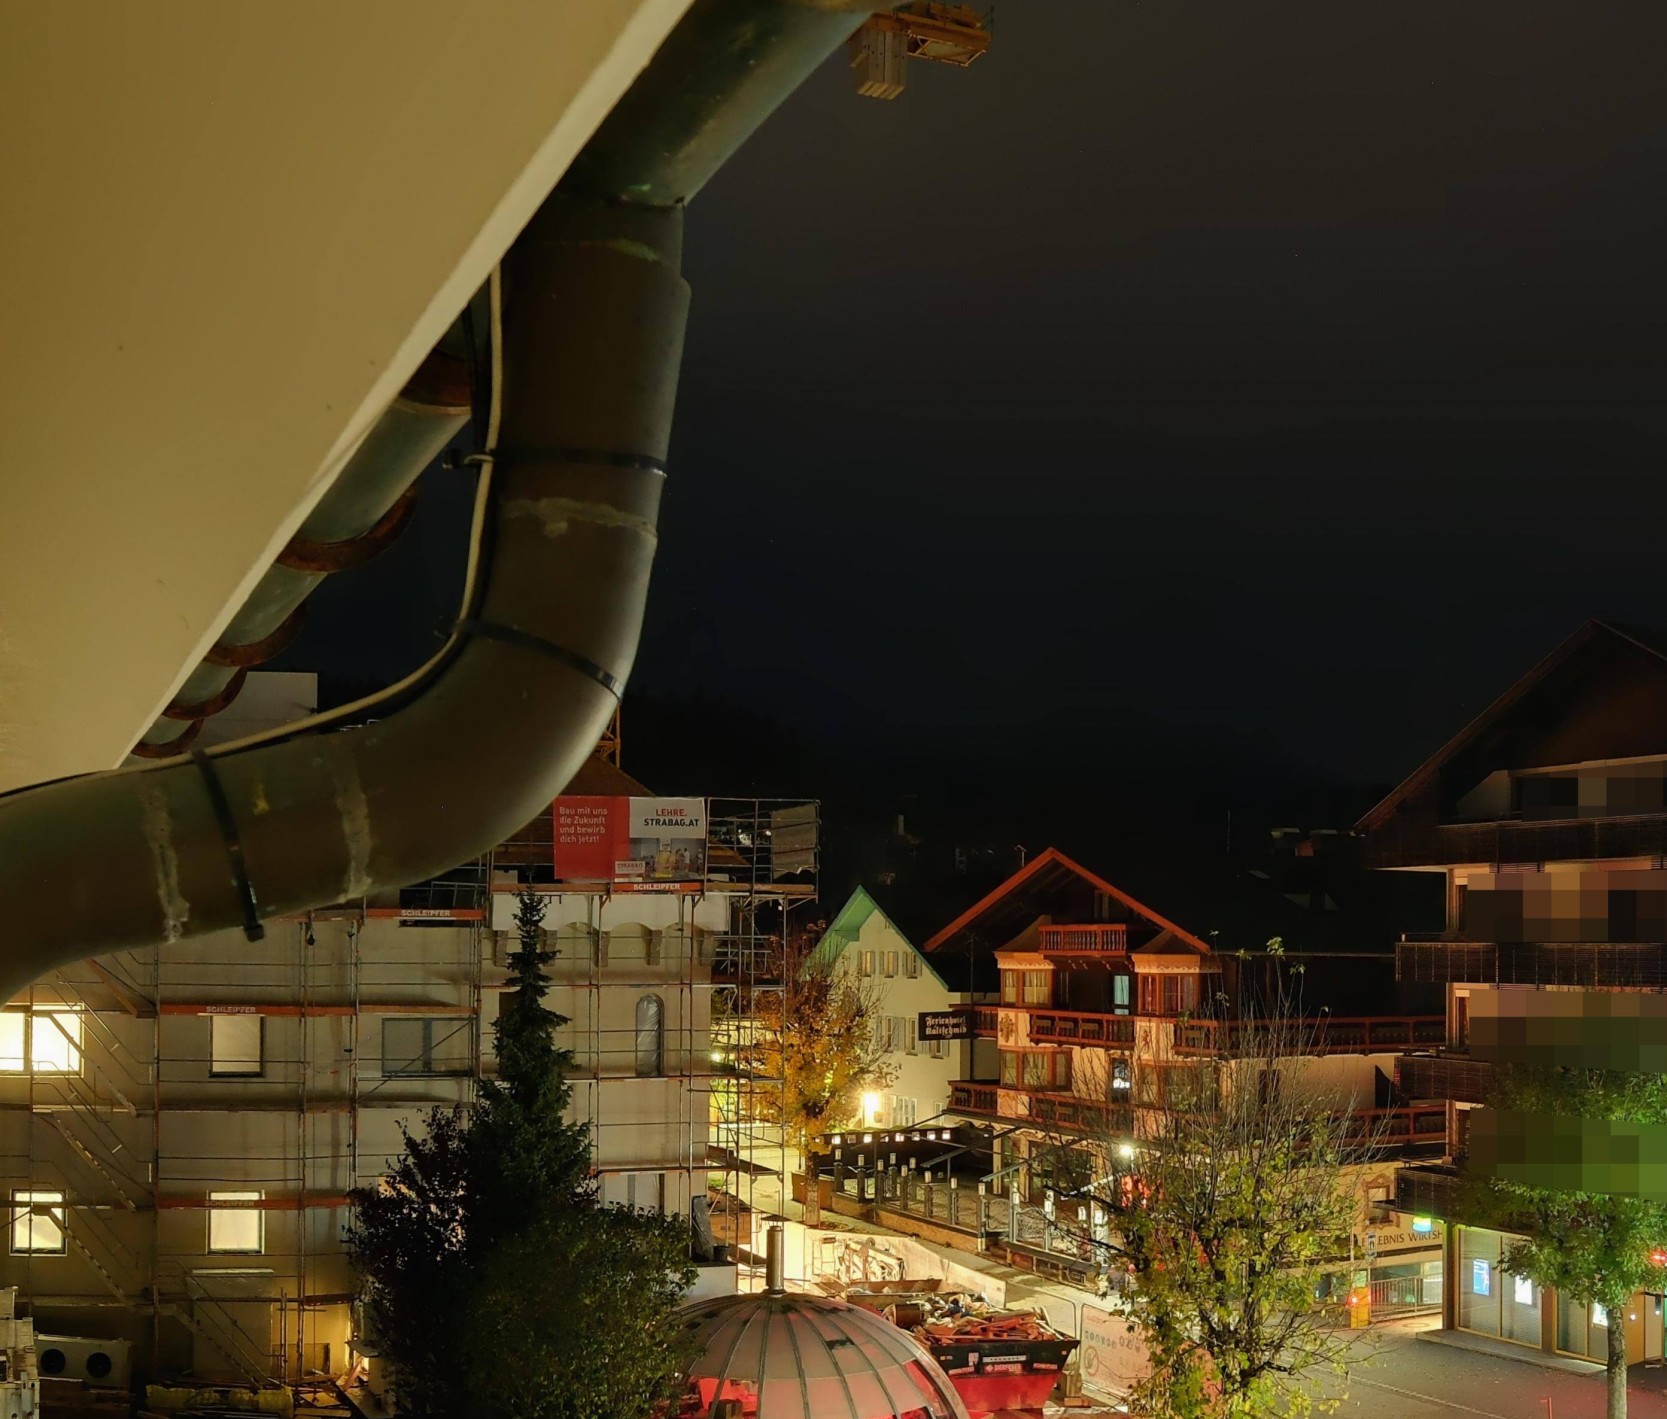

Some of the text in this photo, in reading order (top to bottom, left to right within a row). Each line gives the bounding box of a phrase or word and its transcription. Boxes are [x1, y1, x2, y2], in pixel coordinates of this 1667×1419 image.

[559, 806, 608, 815] Bau mit uns
[655, 808, 687, 817] LEHRE.
[559, 816, 606, 824] die Zukunft
[643, 818, 699, 827] STRABAG.AT
[559, 825, 606, 834] und bewirb
[559, 834, 600, 845] dich jetzt!
[633, 883, 680, 891] SCHLEIPFER
[401, 909, 451, 917] SCHLEIPFER
